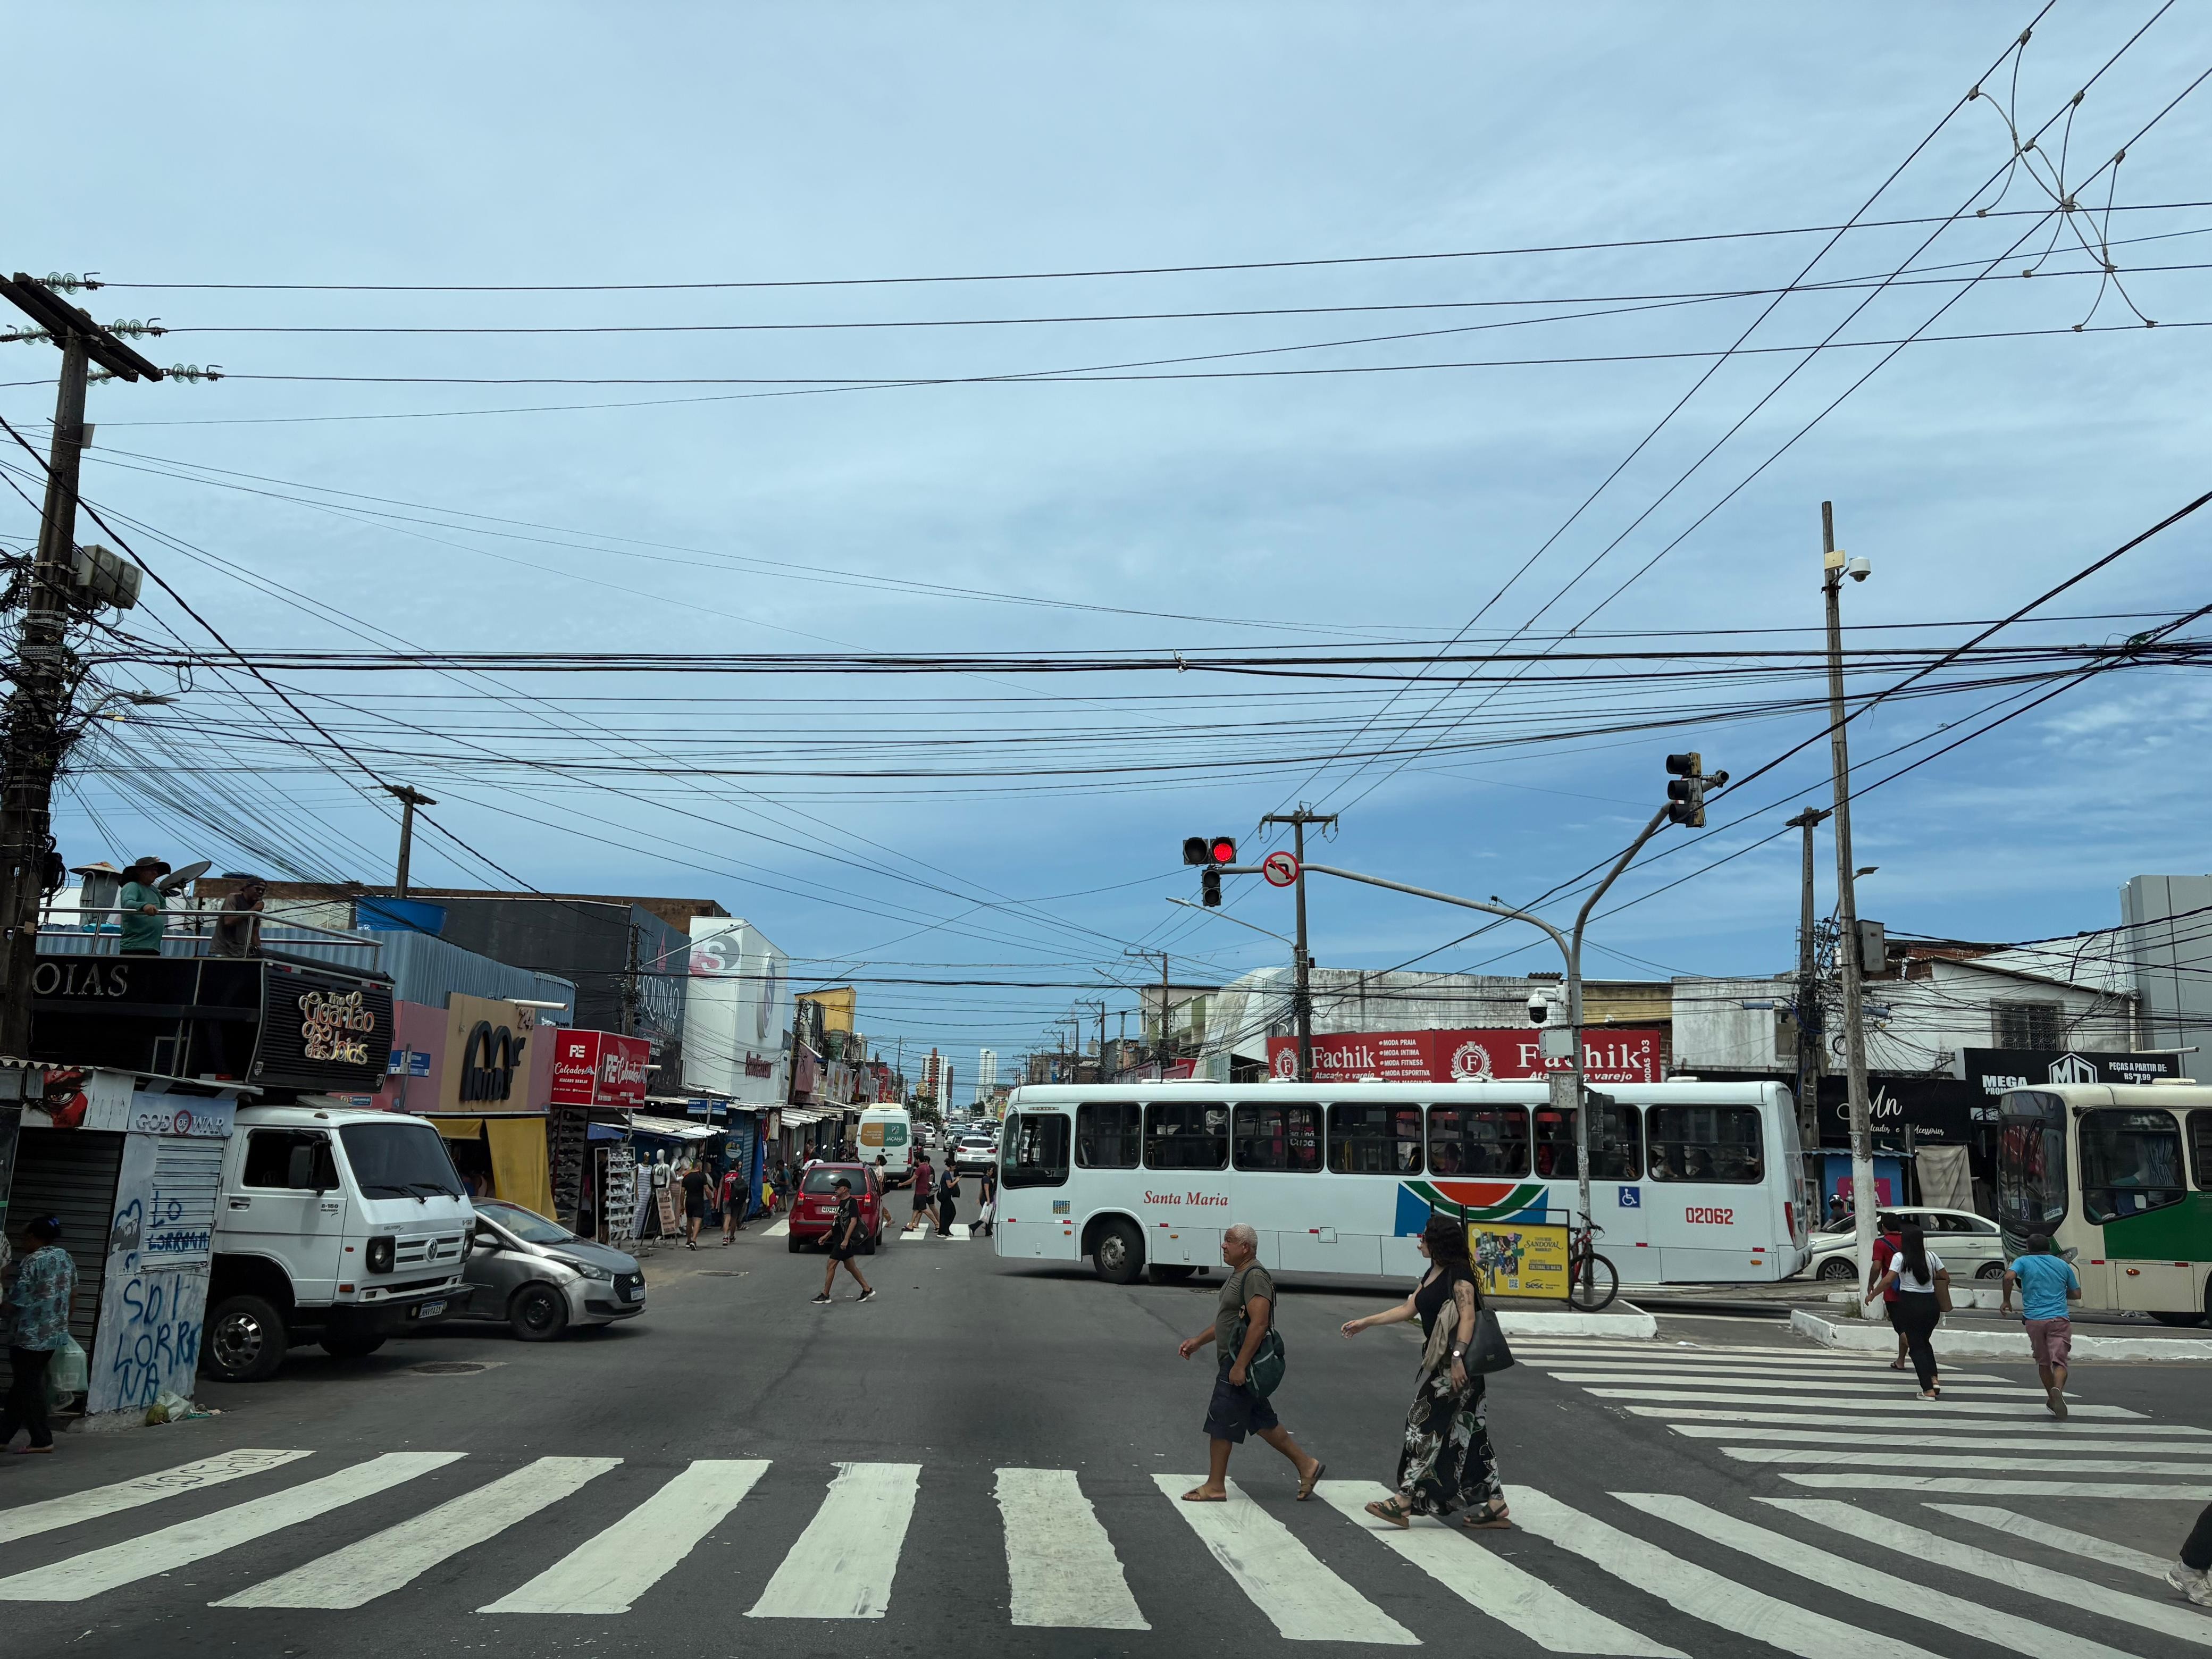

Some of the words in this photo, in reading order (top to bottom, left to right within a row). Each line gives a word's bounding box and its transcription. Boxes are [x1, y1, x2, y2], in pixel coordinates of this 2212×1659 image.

[32, 962, 129, 996] OIAS
[1641, 1040, 1650, 1053] 03
[1311, 1045, 1376, 1069] Fachik
[1465, 1055, 1478, 1071] F
[555, 1062, 585, 1075] Calçados
[1283, 1059, 1291, 1073] F
[2109, 1062, 2129, 1072] PEÇAS
[2134, 1063, 2156, 1072] PARTIR
[2157, 1063, 2167, 1072] DE:
[1595, 1072, 1632, 1082] varejo
[1982, 1075, 2028, 1088] MEGA
[136, 1114, 171, 1132] GOD
[192, 1115, 224, 1136] WAR
[1144, 1191, 1181, 1204] Santa
[1185, 1192, 1228, 1206] Maria
[1686, 1208, 1733, 1225] 02062
[1524, 1240, 1564, 1250] SANDOVAL
